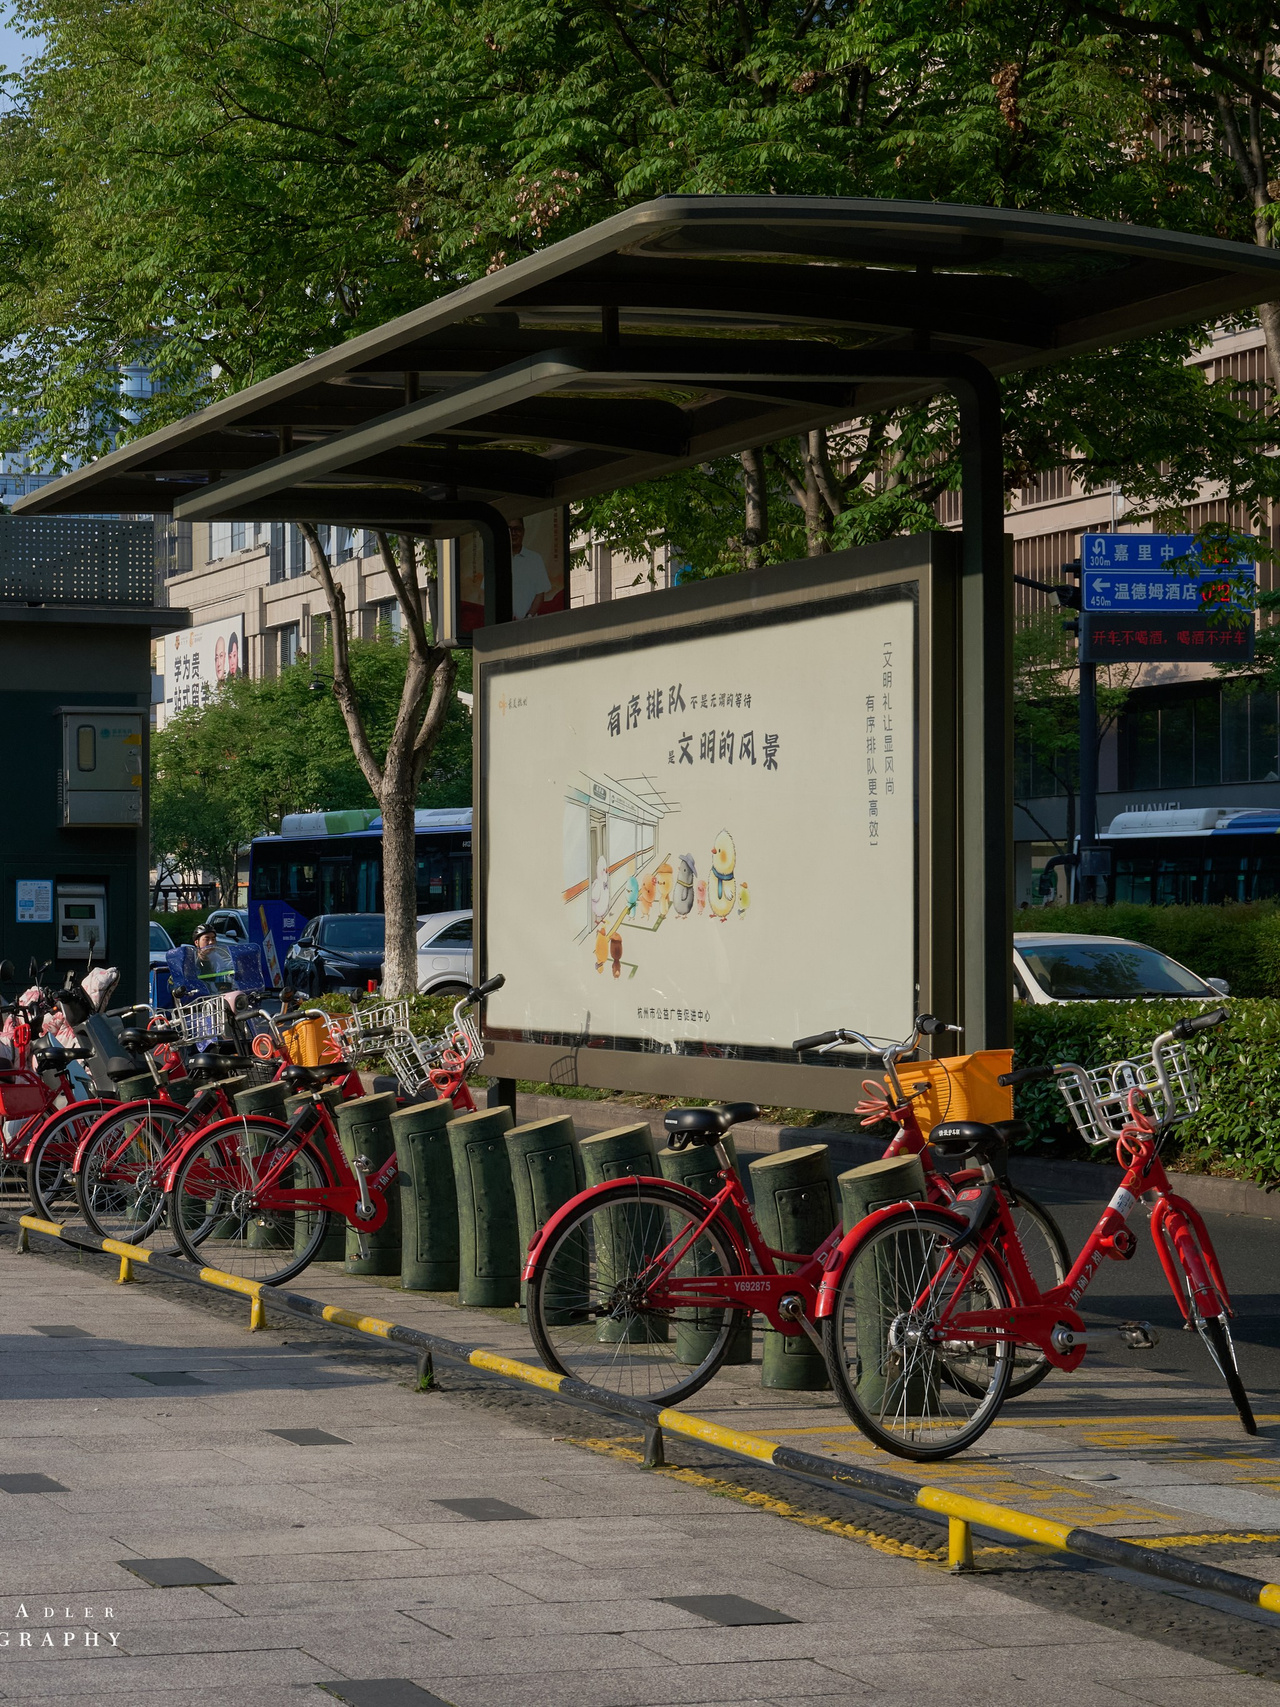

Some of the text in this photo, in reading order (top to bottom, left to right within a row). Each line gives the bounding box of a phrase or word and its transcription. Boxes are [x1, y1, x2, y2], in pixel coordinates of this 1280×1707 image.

[1090, 555, 1111, 567] 300m
[1113, 583, 1198, 601] 温德姆酒店
[1090, 596, 1112, 607] 450m
[637, 1006, 711, 1022] 杭州市公益广告促进中心
[734, 1281, 771, 1292] Y692875
